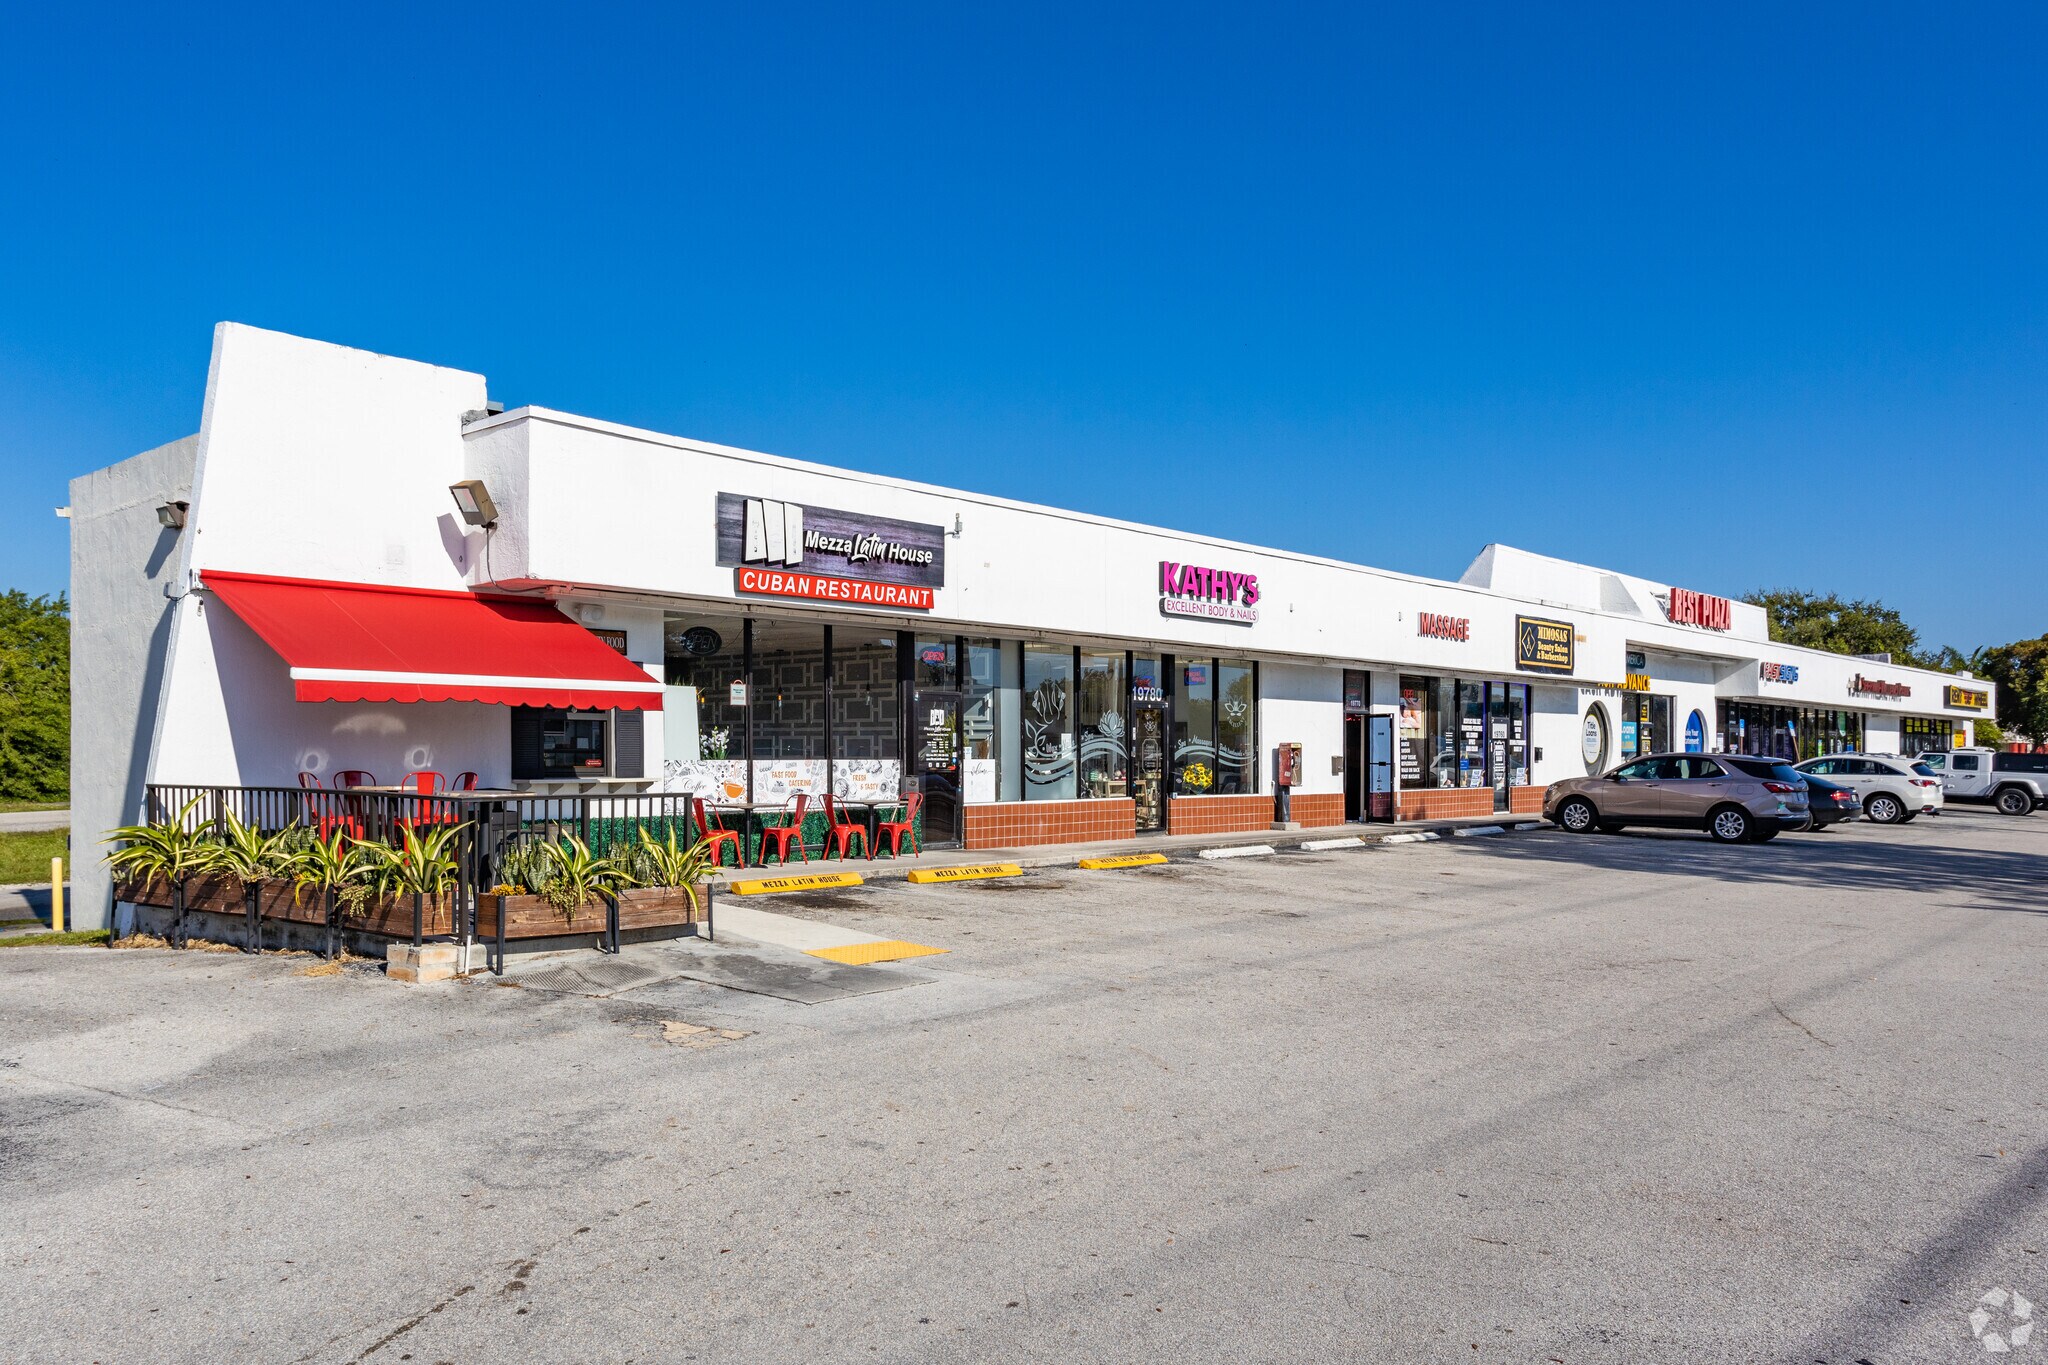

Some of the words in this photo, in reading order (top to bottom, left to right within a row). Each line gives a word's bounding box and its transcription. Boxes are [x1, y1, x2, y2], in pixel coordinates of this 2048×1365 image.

[805, 530, 851, 553] Mezza
[851, 532, 888, 562] Latin
[889, 545, 933, 564] House
[743, 572, 810, 594] CUBAN
[816, 580, 930, 605] RESTAURANT
[1163, 561, 1258, 604] KATHY'S
[1167, 600, 1206, 613] EXCELLENT
[1208, 605, 1229, 616] BODY
[1237, 610, 1257, 621] NAILS
[1675, 588, 1699, 624] BEST
[1703, 595, 1731, 630] PLAZA
[1420, 612, 1469, 640] MASSAGE
[1538, 626, 1568, 642] MIMOSAS
[606, 637, 625, 649] FOOD
[1538, 641, 1555, 653] Beauty
[1554, 644, 1568, 653] Salon
[922, 650, 945, 661] OPEN
[1541, 651, 1569, 664] Barbershop
[1132, 687, 1162, 702] 19780
[788, 779, 812, 787] CATERING
[852, 773, 867, 782] FRESH
[865, 783, 880, 791] TASTY
[934, 869, 958, 878] MEZZA
[960, 867, 980, 876] LATIN
[983, 865, 1004, 874] HOUSE
[761, 880, 789, 889] MEZZA
[793, 877, 815, 886] LATIN
[818, 875, 842, 884] HOUSE
